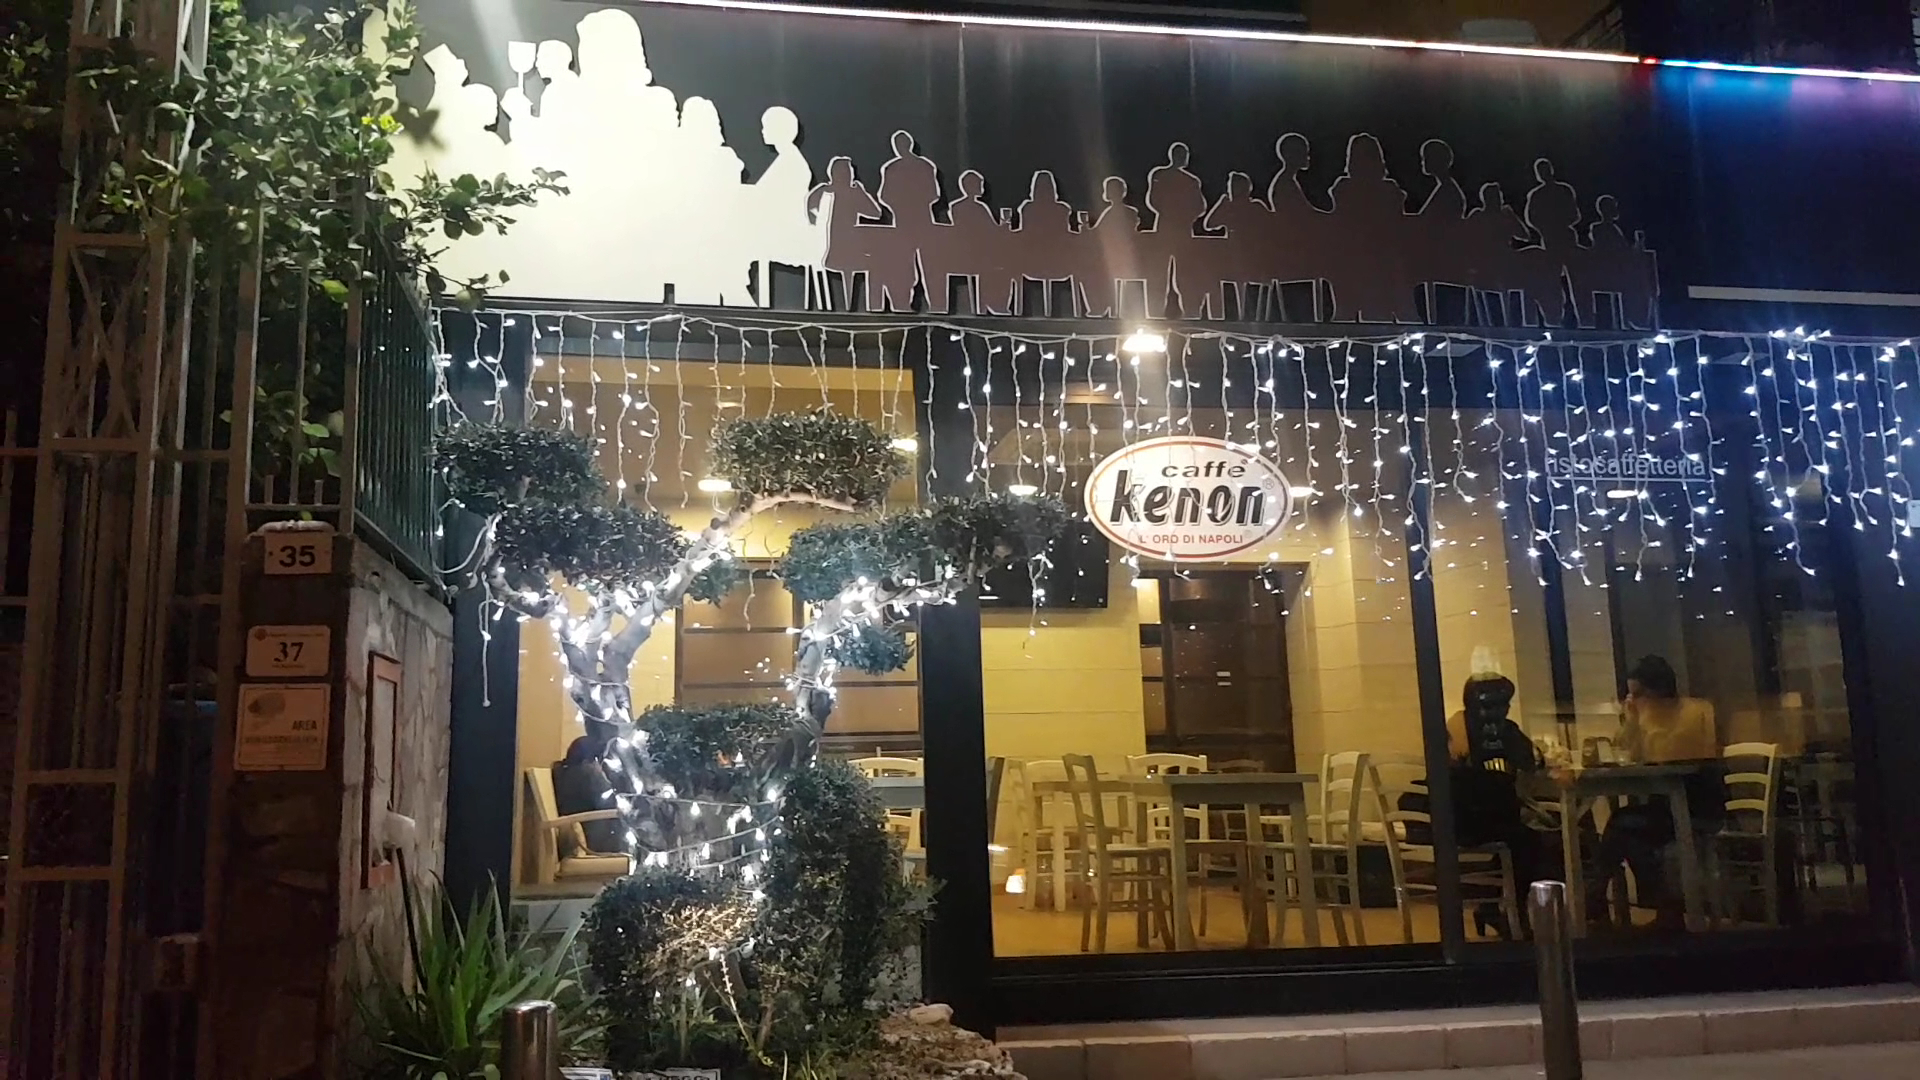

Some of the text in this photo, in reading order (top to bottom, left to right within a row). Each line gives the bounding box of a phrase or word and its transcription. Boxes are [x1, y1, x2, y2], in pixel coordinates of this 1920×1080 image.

[1545, 453, 1706, 476] ristocaffetteria
[1110, 470, 1266, 526] kenon
[1183, 534, 1195, 544] DI
[1198, 534, 1243, 544] NAPOLI
[279, 545, 316, 568] 35
[273, 641, 304, 662] 37
[292, 720, 318, 731] AREA
